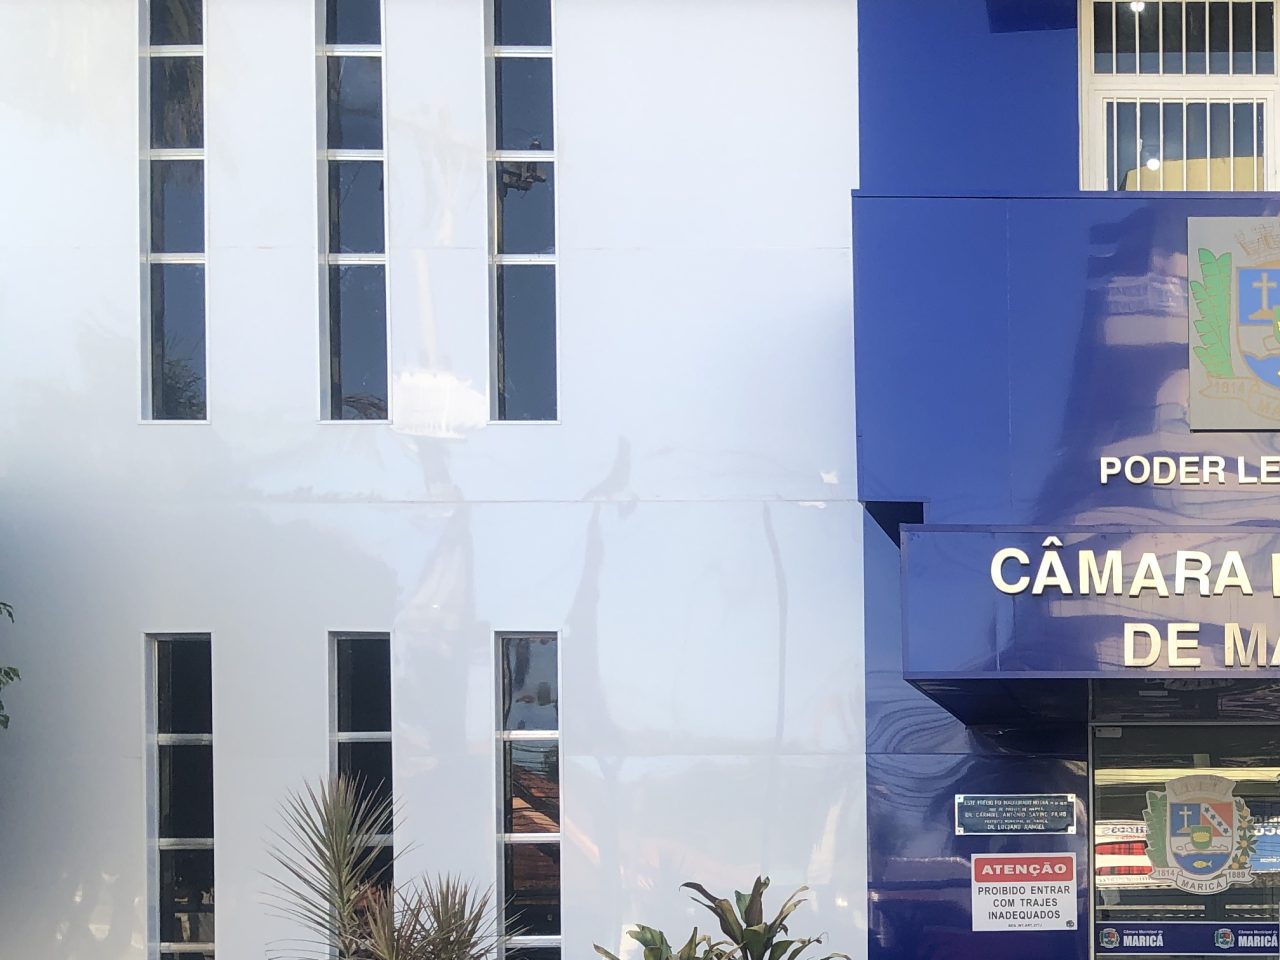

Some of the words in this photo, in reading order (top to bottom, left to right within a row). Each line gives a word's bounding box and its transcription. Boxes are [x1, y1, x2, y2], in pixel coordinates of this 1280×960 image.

[1100, 454, 1226, 485] PODER
[990, 536, 1253, 598] CÂMARA
[1123, 622, 1201, 667] DE
[981, 862, 1067, 877] ATENÇÃO
[1158, 869, 1175, 878] 1814
[1228, 870, 1246, 880] 1889
[978, 886, 1026, 896] PROIBIDO
[1030, 885, 1070, 895] ENTRAR
[1181, 879, 1223, 891] MARICÁ
[993, 898, 1015, 908] COM
[1020, 898, 1058, 907] TRAJES
[988, 910, 1061, 920] INADEQUADOS
[1123, 933, 1164, 947] MARICÁ
[1238, 933, 1279, 947] MARICÁ
